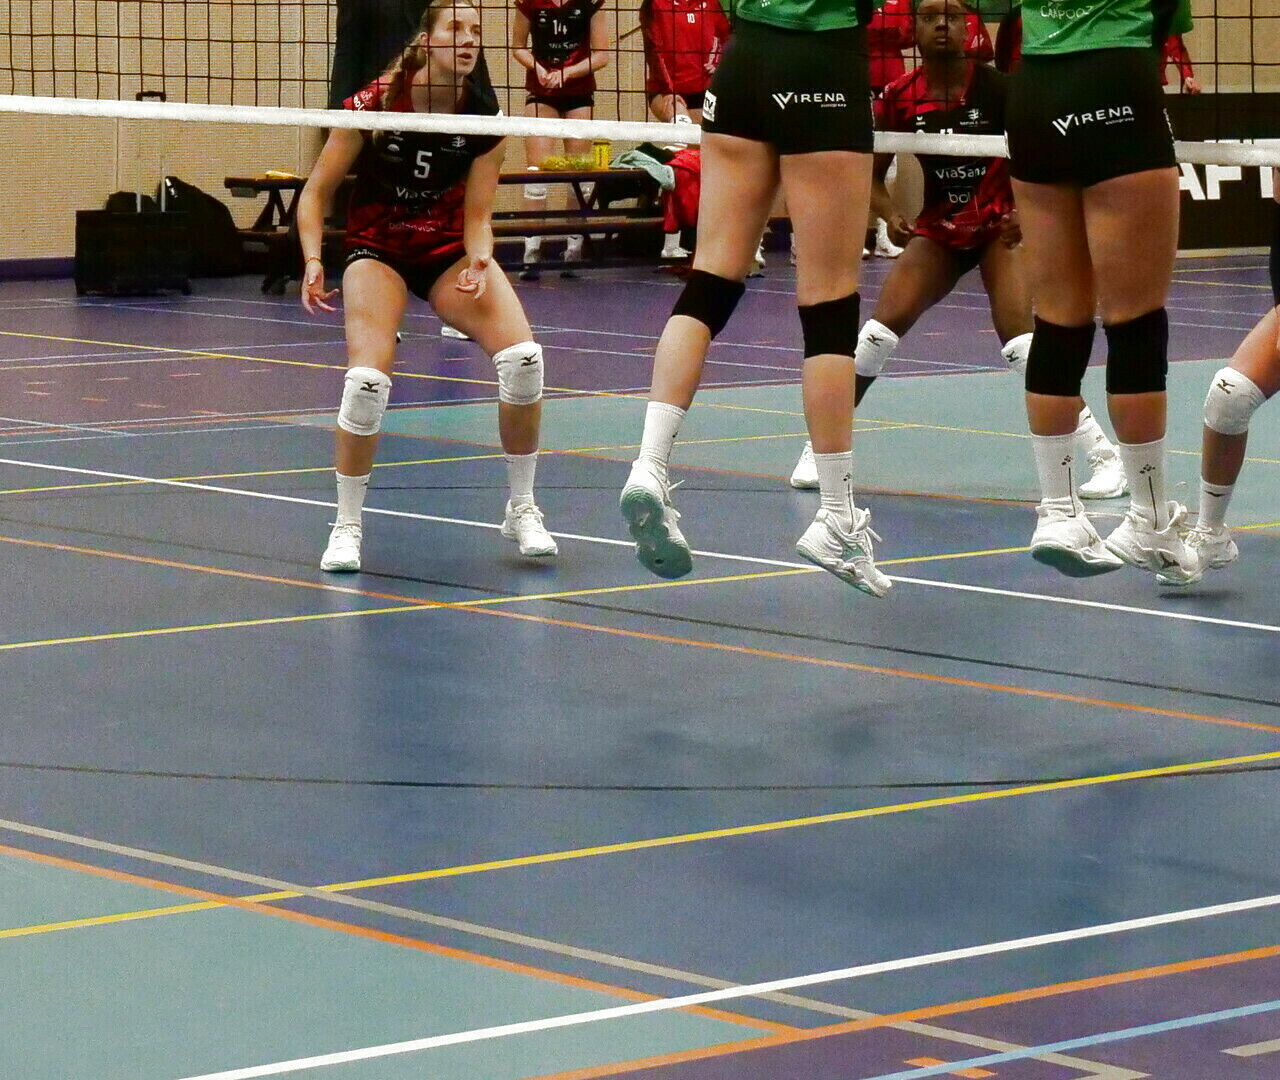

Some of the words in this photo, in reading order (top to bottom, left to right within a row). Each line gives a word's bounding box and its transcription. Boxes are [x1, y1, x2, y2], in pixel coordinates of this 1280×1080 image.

[772, 91, 846, 110] VIRENA
[1052, 105, 1133, 136] VIRENA
[413, 150, 433, 179] 5
